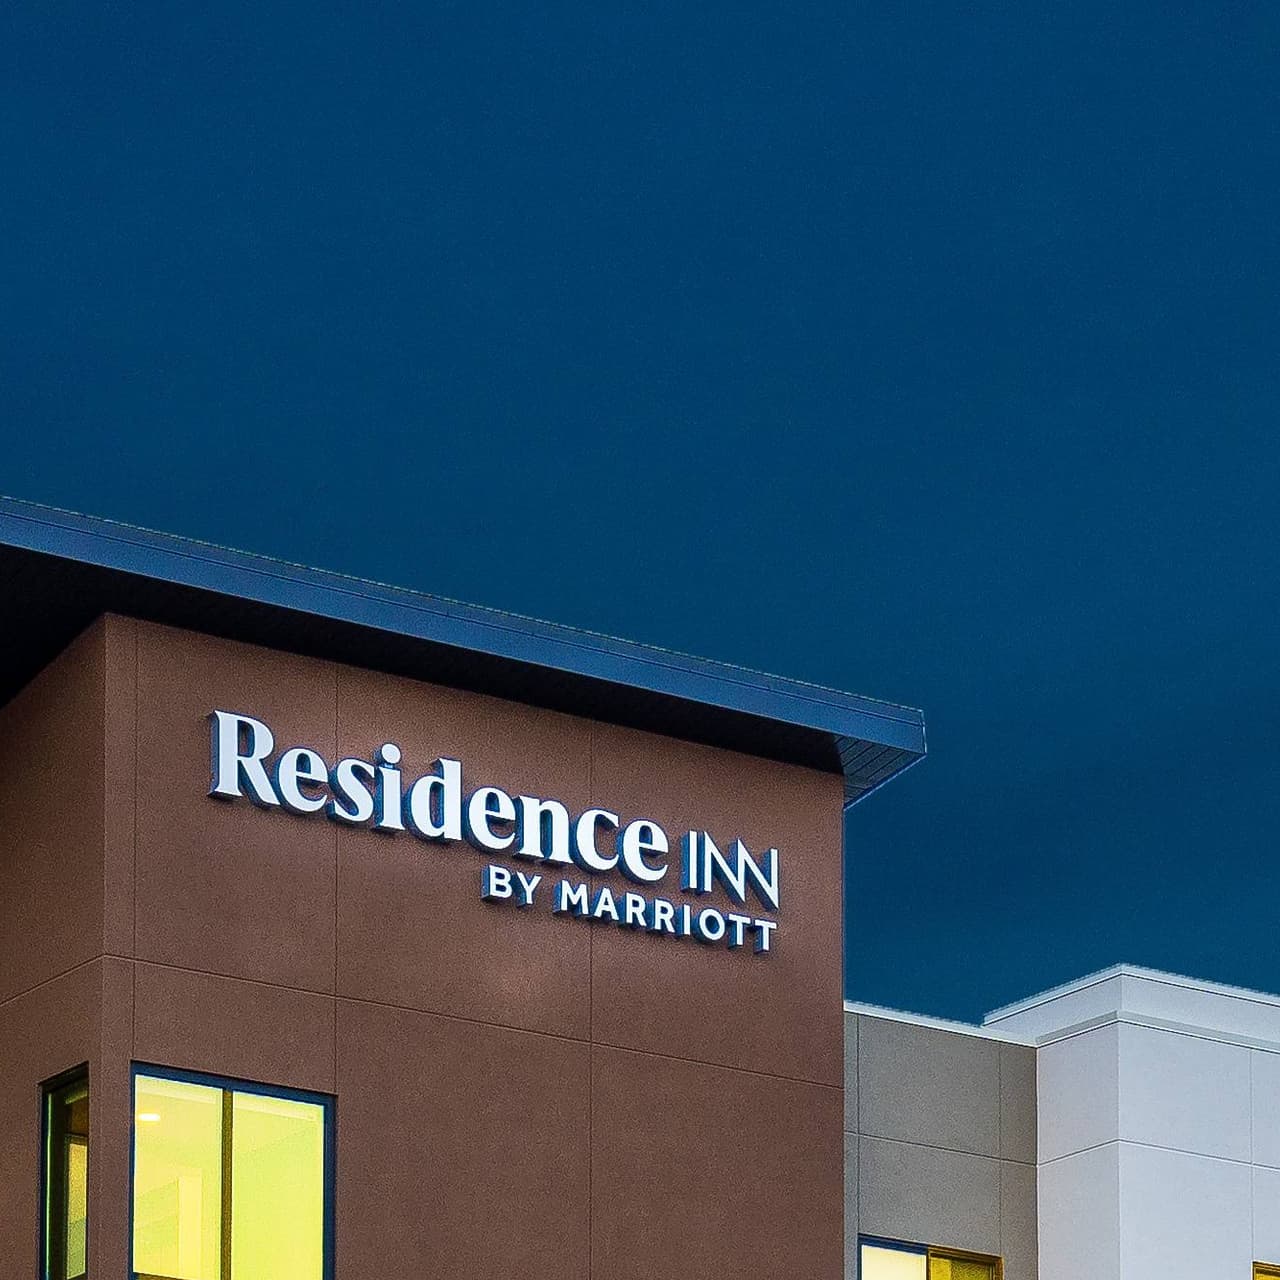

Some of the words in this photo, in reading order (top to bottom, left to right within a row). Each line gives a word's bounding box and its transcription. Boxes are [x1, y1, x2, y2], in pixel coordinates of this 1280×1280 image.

[212, 709, 669, 882] Residence
[685, 829, 779, 910] INN
[487, 865, 542, 906] BY
[558, 879, 778, 953] MARRIOTT
